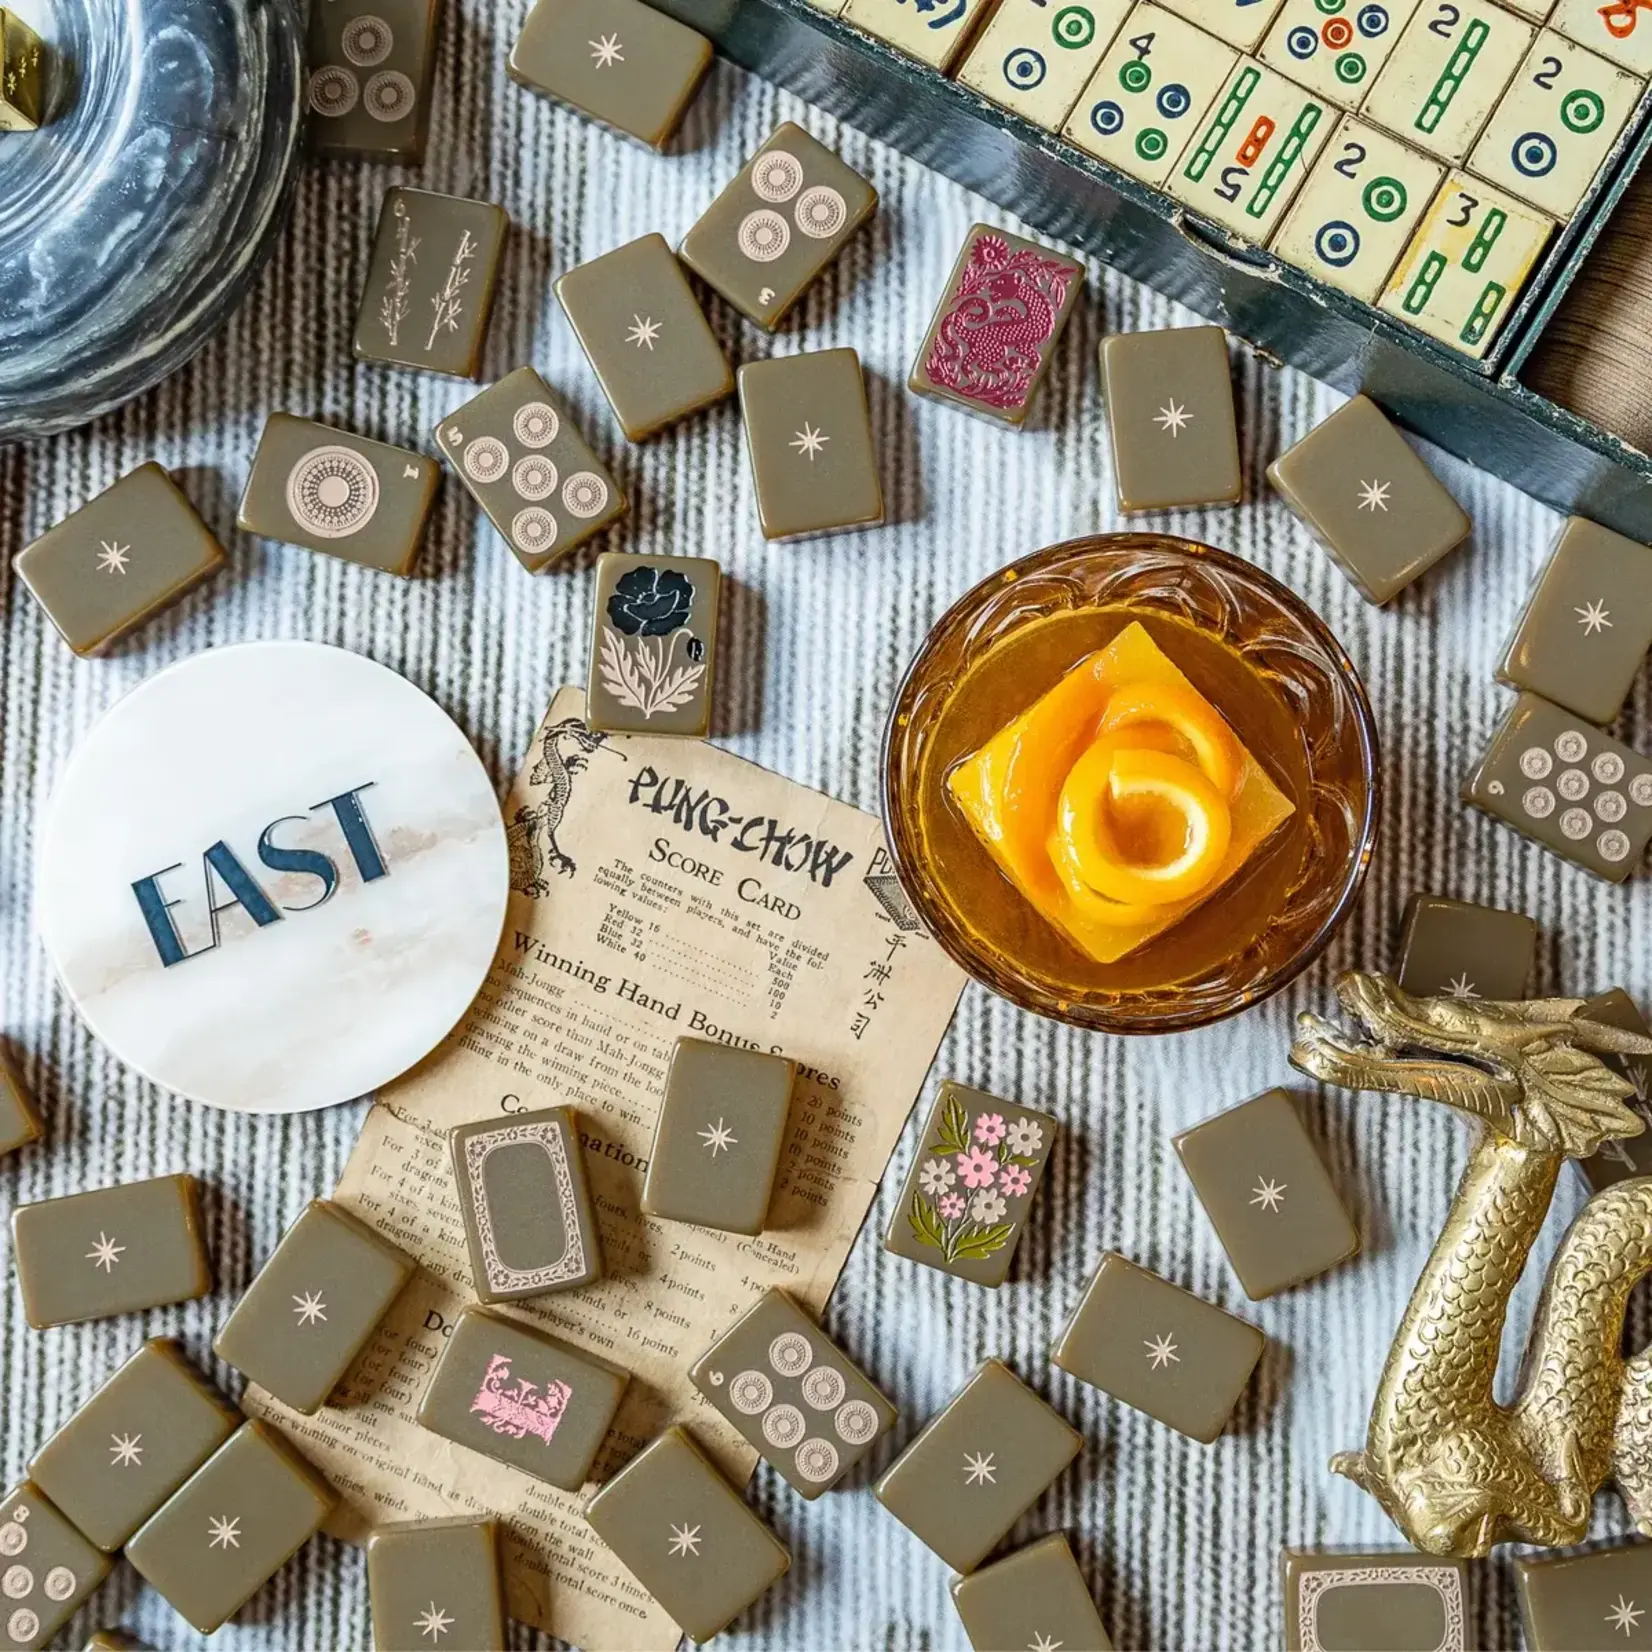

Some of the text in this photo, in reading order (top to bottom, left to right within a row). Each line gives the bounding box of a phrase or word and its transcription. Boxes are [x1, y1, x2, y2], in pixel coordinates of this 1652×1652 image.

[1429, 4, 1460, 38] 2
[1129, 32, 1155, 60] 4
[1533, 56, 1562, 90] 2
[1334, 142, 1366, 179] 2
[1214, 167, 1250, 203] 5
[1446, 192, 1479, 227] 3
[759, 288, 775, 305] 3
[447, 426, 464, 446] 5
[627, 765, 854, 888] PUNG-CHOW
[130, 781, 387, 968] EAST
[592, 873, 668, 913] lowing values:
[596, 865, 824, 970] equally between players, and have the fol-
[613, 857, 830, 962] The counters with this set are divided
[598, 922, 782, 1010] Blue 32 10
[602, 913, 786, 1000] Red 32 100
[608, 903, 790, 990] Yellow 16 500
[768, 950, 798, 971] Value
[514, 930, 612, 994] Winning
[615, 977, 682, 1021] Hand
[596, 932, 778, 1020] White 40 2
[766, 962, 793, 981] Each
[497, 958, 863, 1127] Mah-Jongg 20 points
[494, 998, 528, 1017] other
[530, 1013, 562, 1033] score
[565, 1027, 593, 1047] than
[595, 1038, 665, 1080] Mah-Jongg
[793, 1126, 809, 1141] 10
[810, 1137, 850, 1160] points
[506, 983, 562, 1014] sequences
[564, 1010, 578, 1022] in
[580, 1014, 613, 1037] hand
[614, 1032, 631, 1044] or
[631, 1040, 648, 1052] on
[799, 1110, 816, 1125] 10
[817, 1121, 856, 1144] points
[464, 1021, 514, 1051] drawing
[516, 1043, 537, 1059] the
[541, 1056, 589, 1083] winning
[796, 1167, 836, 1191] points
[473, 1006, 843, 1175] winning on a draw from the 10 points
[394, 1105, 418, 1125] For
[457, 1037, 829, 1207] filling in the only place to 2 points
[369, 1164, 434, 1202] For 4 of a
[381, 1134, 652, 1262] For 3 of a or
[400, 1159, 448, 1189] dragons
[658, 1273, 668, 1284] 4
[666, 1278, 705, 1301] points
[357, 1192, 628, 1320] For 4 of a kind winds or
[670, 1242, 681, 1255] 2
[678, 1249, 716, 1272] points
[735, 1240, 799, 1274] (Concealed)
[766, 1242, 796, 1262] Hand
[375, 1216, 679, 1358] dragons 16 points
[425, 1259, 450, 1276] any
[536, 1308, 586, 1336] player's
[588, 1331, 615, 1349] own
[643, 1299, 691, 1329] 8 points
[397, 1350, 431, 1375] four)
[404, 1335, 438, 1360] four)
[378, 1380, 412, 1405] four)
[387, 1365, 421, 1389] four)
[709, 1371, 724, 1386] 6
[372, 1400, 395, 1416] one
[316, 1410, 352, 1434] honor
[354, 1430, 390, 1452] pieces
[517, 1500, 557, 1526] double
[558, 1519, 589, 1539] total
[354, 1411, 378, 1427] suit
[524, 1483, 565, 1510] double
[261, 1405, 286, 1424] For
[290, 1419, 339, 1449] winning
[341, 1443, 358, 1456] on
[360, 1452, 410, 1479] original
[446, 1490, 460, 1500] as
[508, 1513, 539, 1538] from
[543, 1531, 563, 1548] the
[567, 1543, 595, 1561] wall
[332, 1472, 408, 1512] nines, winds
[546, 1548, 576, 1568] total
[575, 1562, 609, 1582] score
[610, 1575, 619, 1587] 3
[554, 1571, 585, 1591] total
[584, 1585, 617, 1605] score
